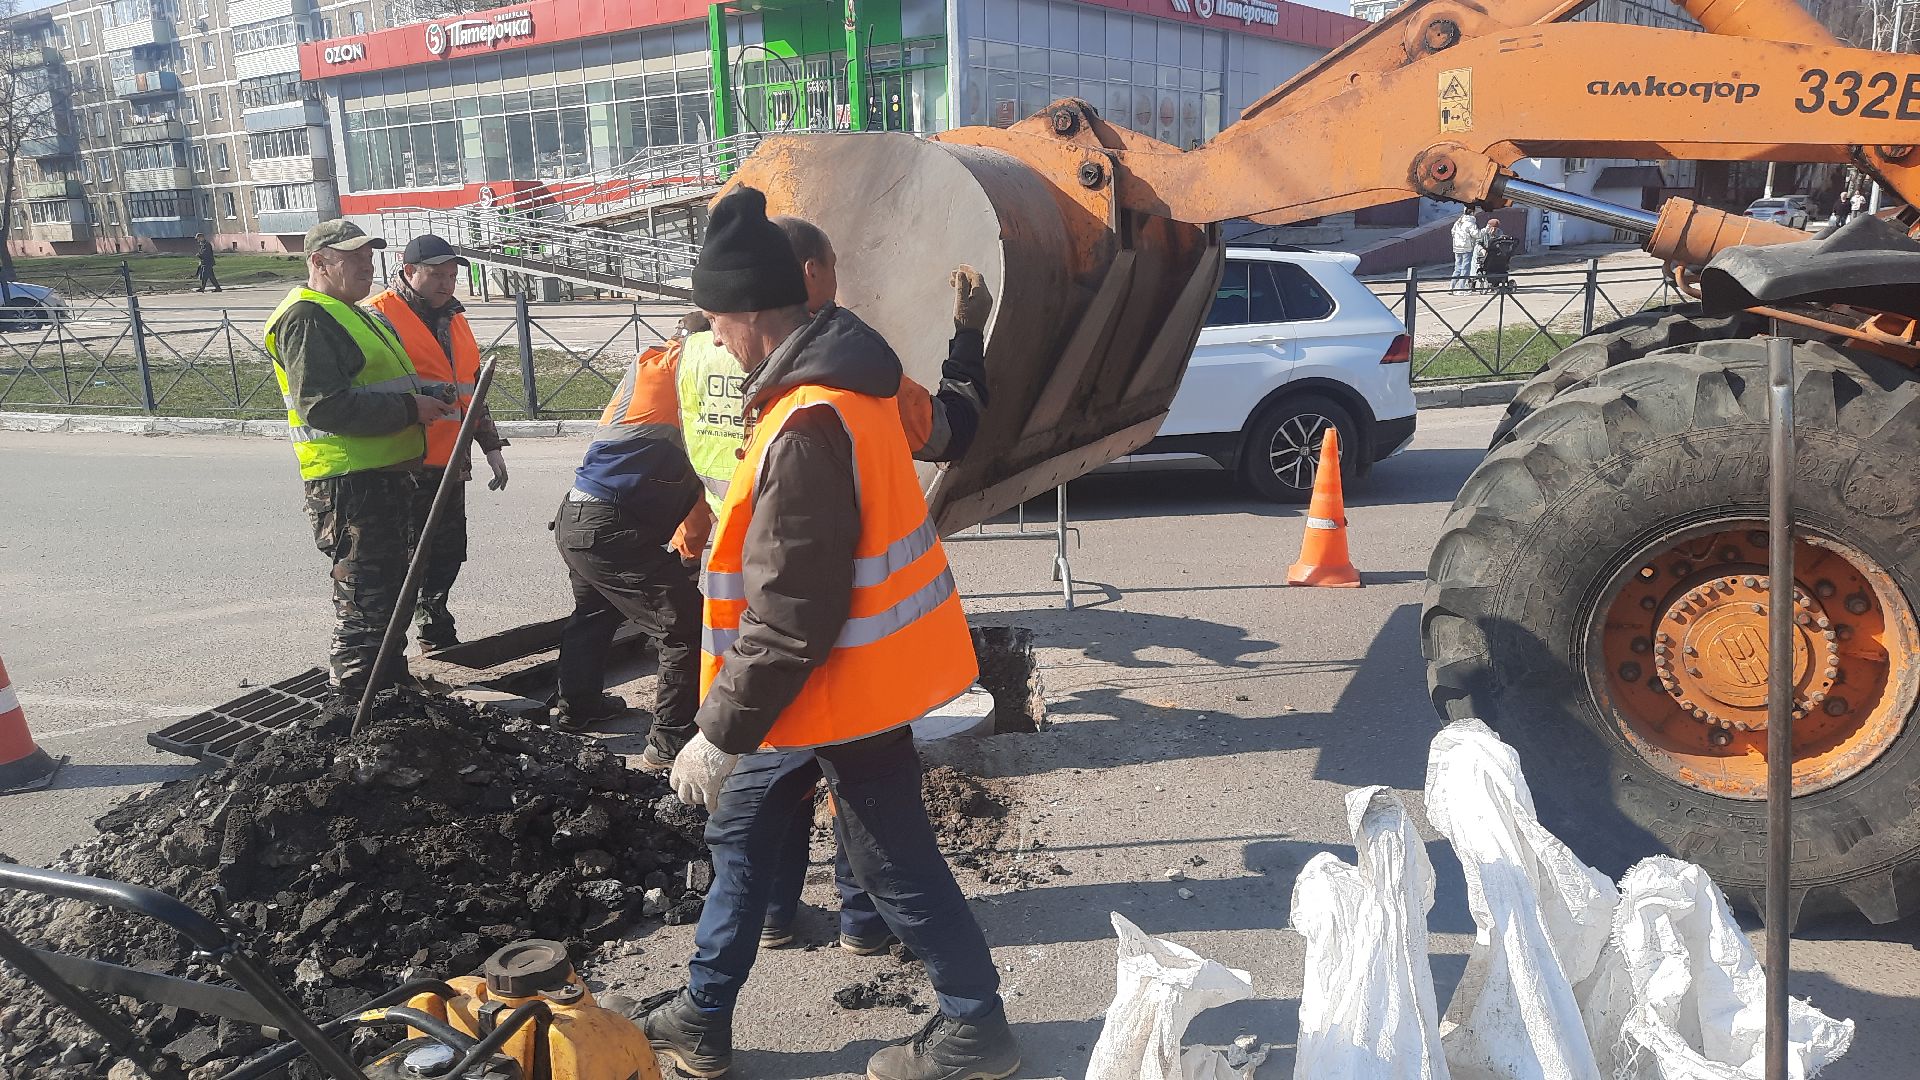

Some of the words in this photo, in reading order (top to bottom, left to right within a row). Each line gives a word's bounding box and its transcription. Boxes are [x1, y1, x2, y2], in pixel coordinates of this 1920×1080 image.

[1215, 0, 1279, 26] Пятерочка
[445, 18, 532, 48] Пятерочка
[324, 43, 364, 64] OZON
